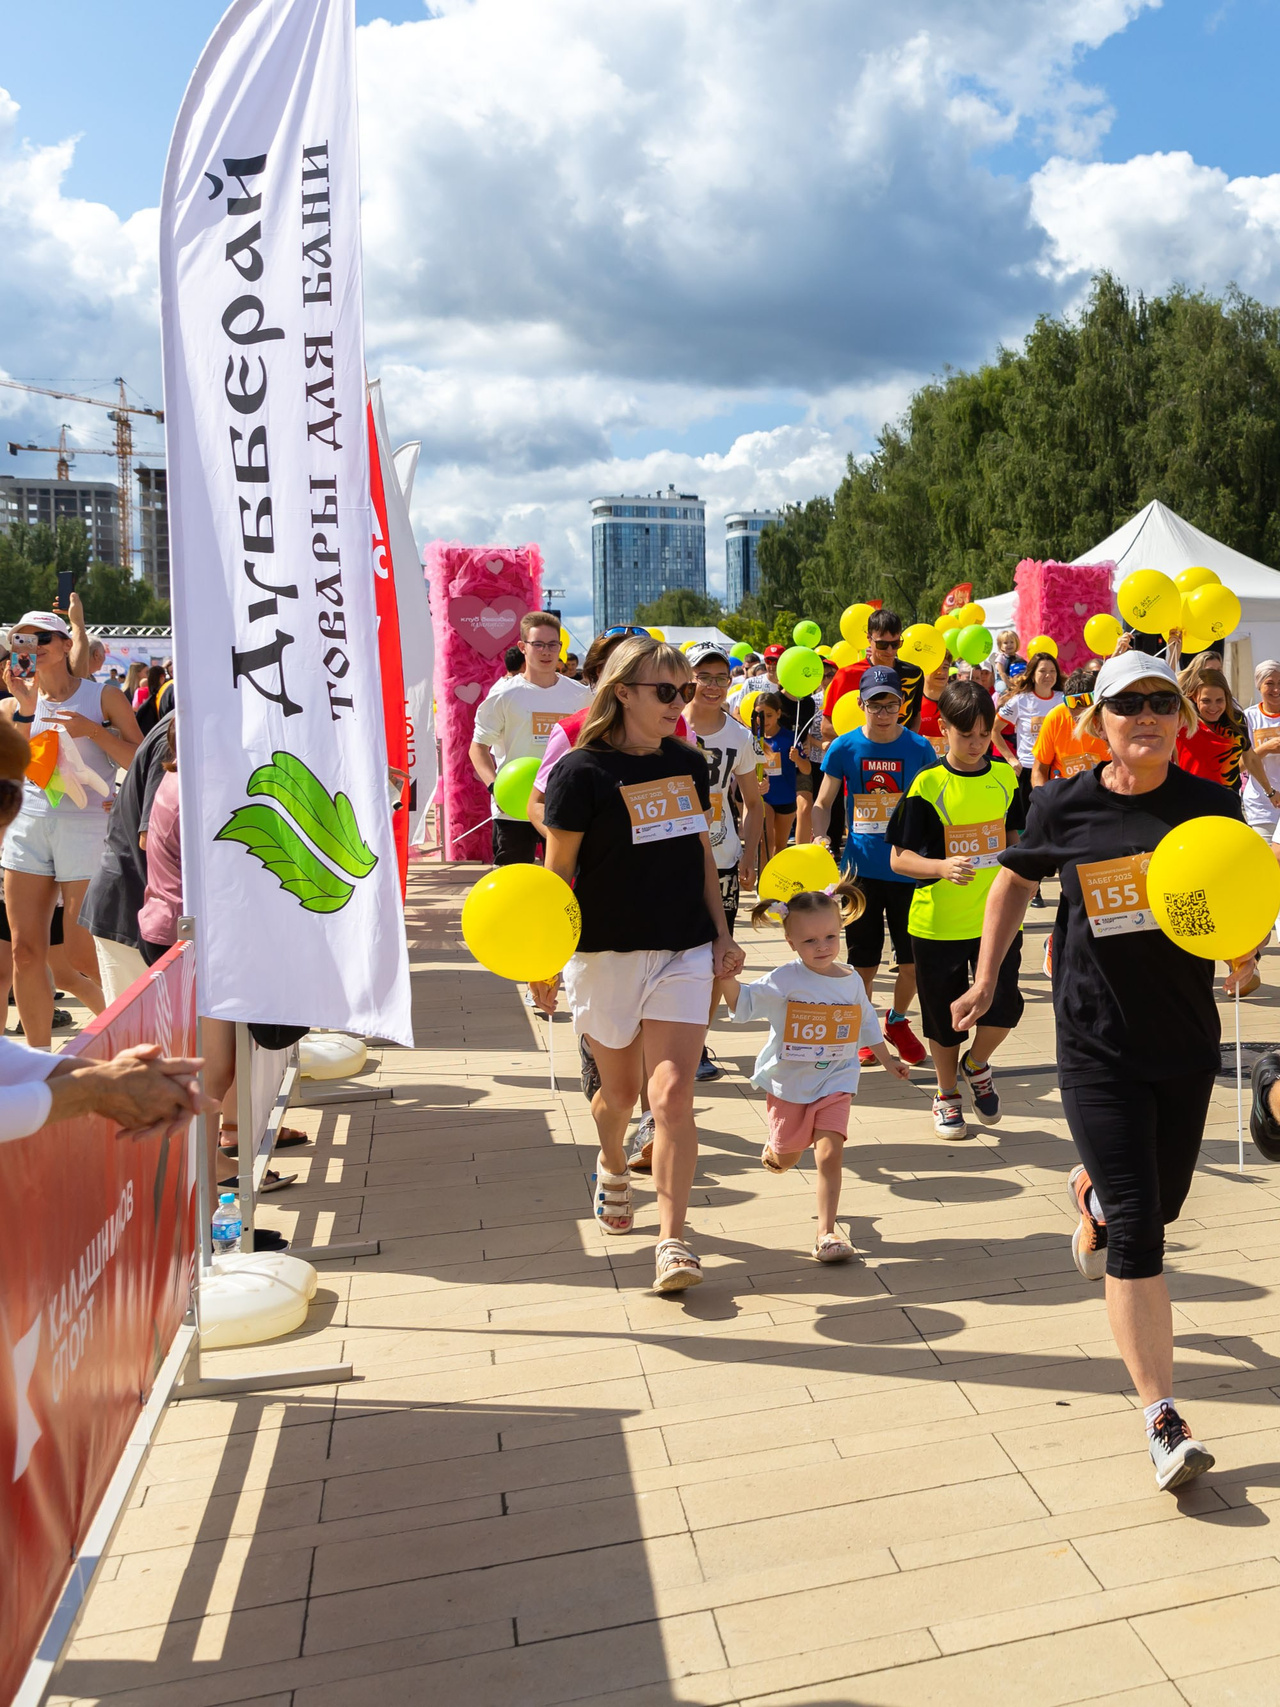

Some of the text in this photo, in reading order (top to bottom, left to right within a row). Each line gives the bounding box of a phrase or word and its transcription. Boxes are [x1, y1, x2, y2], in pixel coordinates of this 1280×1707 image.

[301, 139, 355, 721] ТОВАРЫ ДЛЯ БАНИ
[868, 761, 897, 772] MARIO
[1066, 763, 1086, 775] 052
[634, 799, 668, 819] 167
[856, 807, 878, 818] 007
[949, 839, 980, 854] 006
[1087, 872, 1133, 885] ЗАБЕГ 2025
[1091, 884, 1139, 910] 155
[791, 1023, 827, 1040] 169
[50, 1179, 134, 1350] КАЛАШНИОВ
[52, 1293, 95, 1404] СПОРТ
